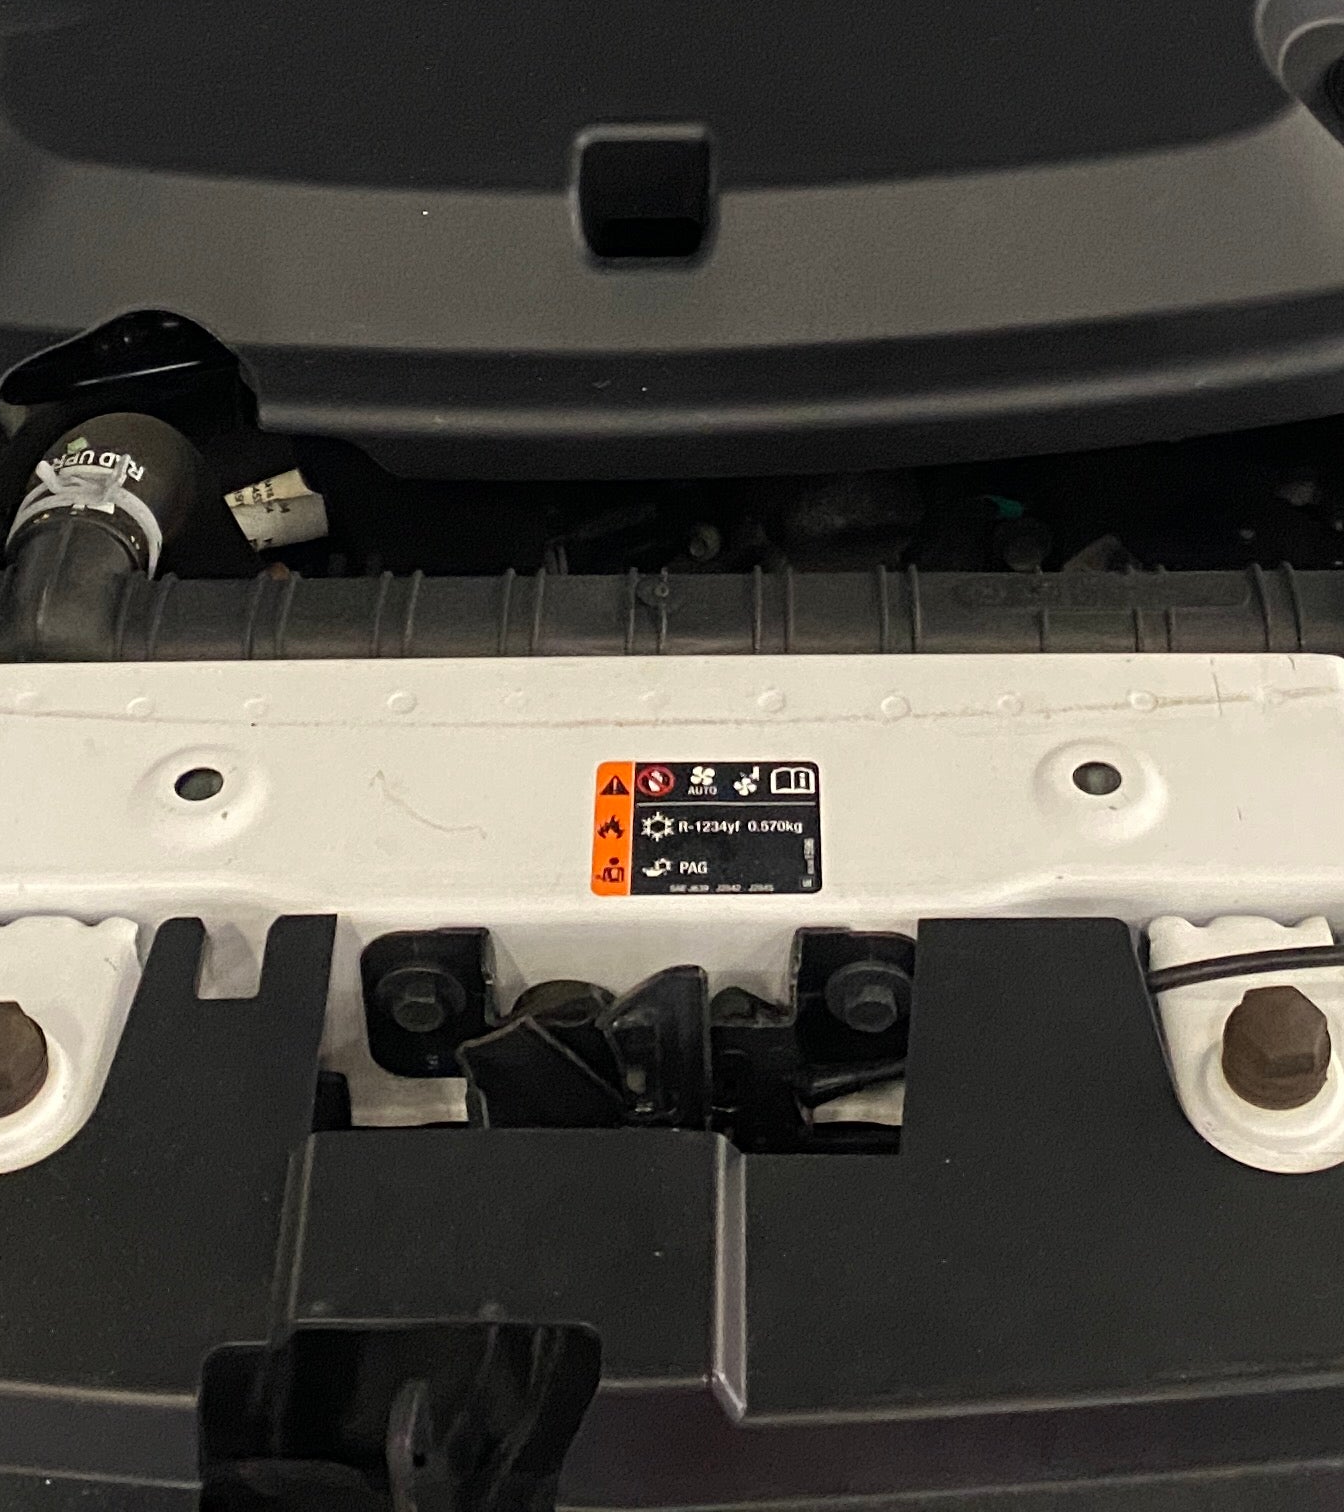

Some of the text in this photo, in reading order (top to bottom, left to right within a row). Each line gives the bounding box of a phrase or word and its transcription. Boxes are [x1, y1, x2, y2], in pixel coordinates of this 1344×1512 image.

[99, 451, 144, 482] RD
[687, 785, 718, 796] AUTO
[678, 819, 741, 834] R-1234yf
[679, 860, 708, 874] PAG
